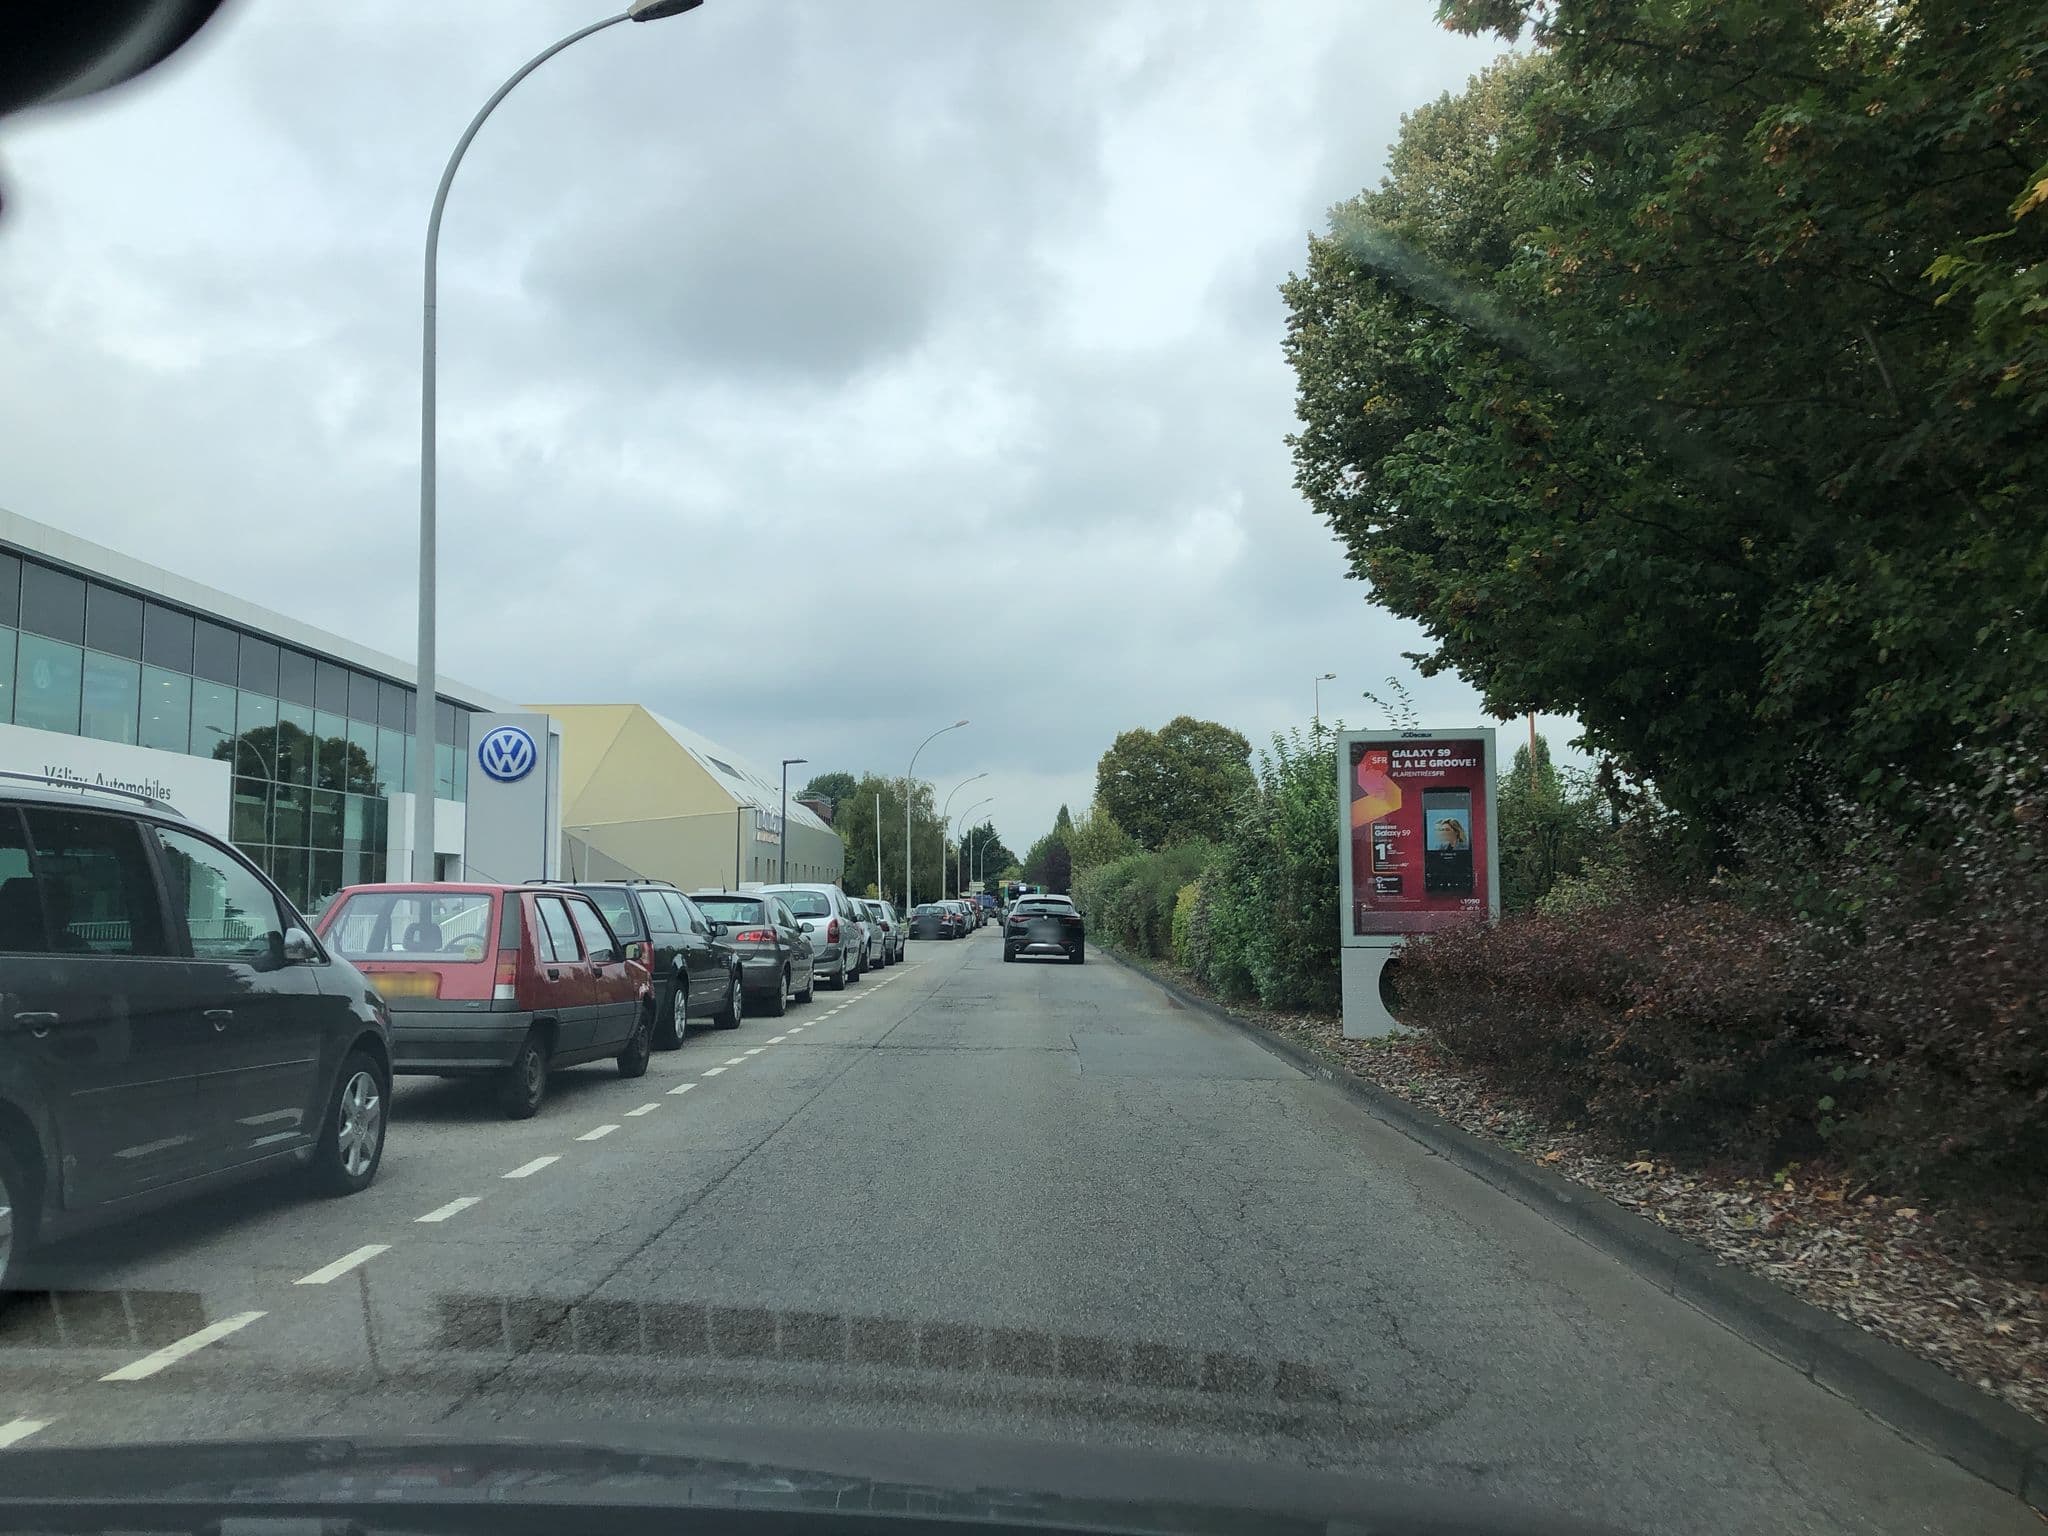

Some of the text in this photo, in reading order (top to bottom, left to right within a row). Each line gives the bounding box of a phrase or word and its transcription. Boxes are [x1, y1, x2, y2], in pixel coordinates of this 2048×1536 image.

[1392, 748, 1451, 758] GALAXY S9
[1372, 756, 1388, 765] SFR
[1392, 758, 1477, 768] IL A LE GROOVE!
[95, 772, 171, 800] Automobiles
[1374, 829, 1411, 838] Galaxy S9
